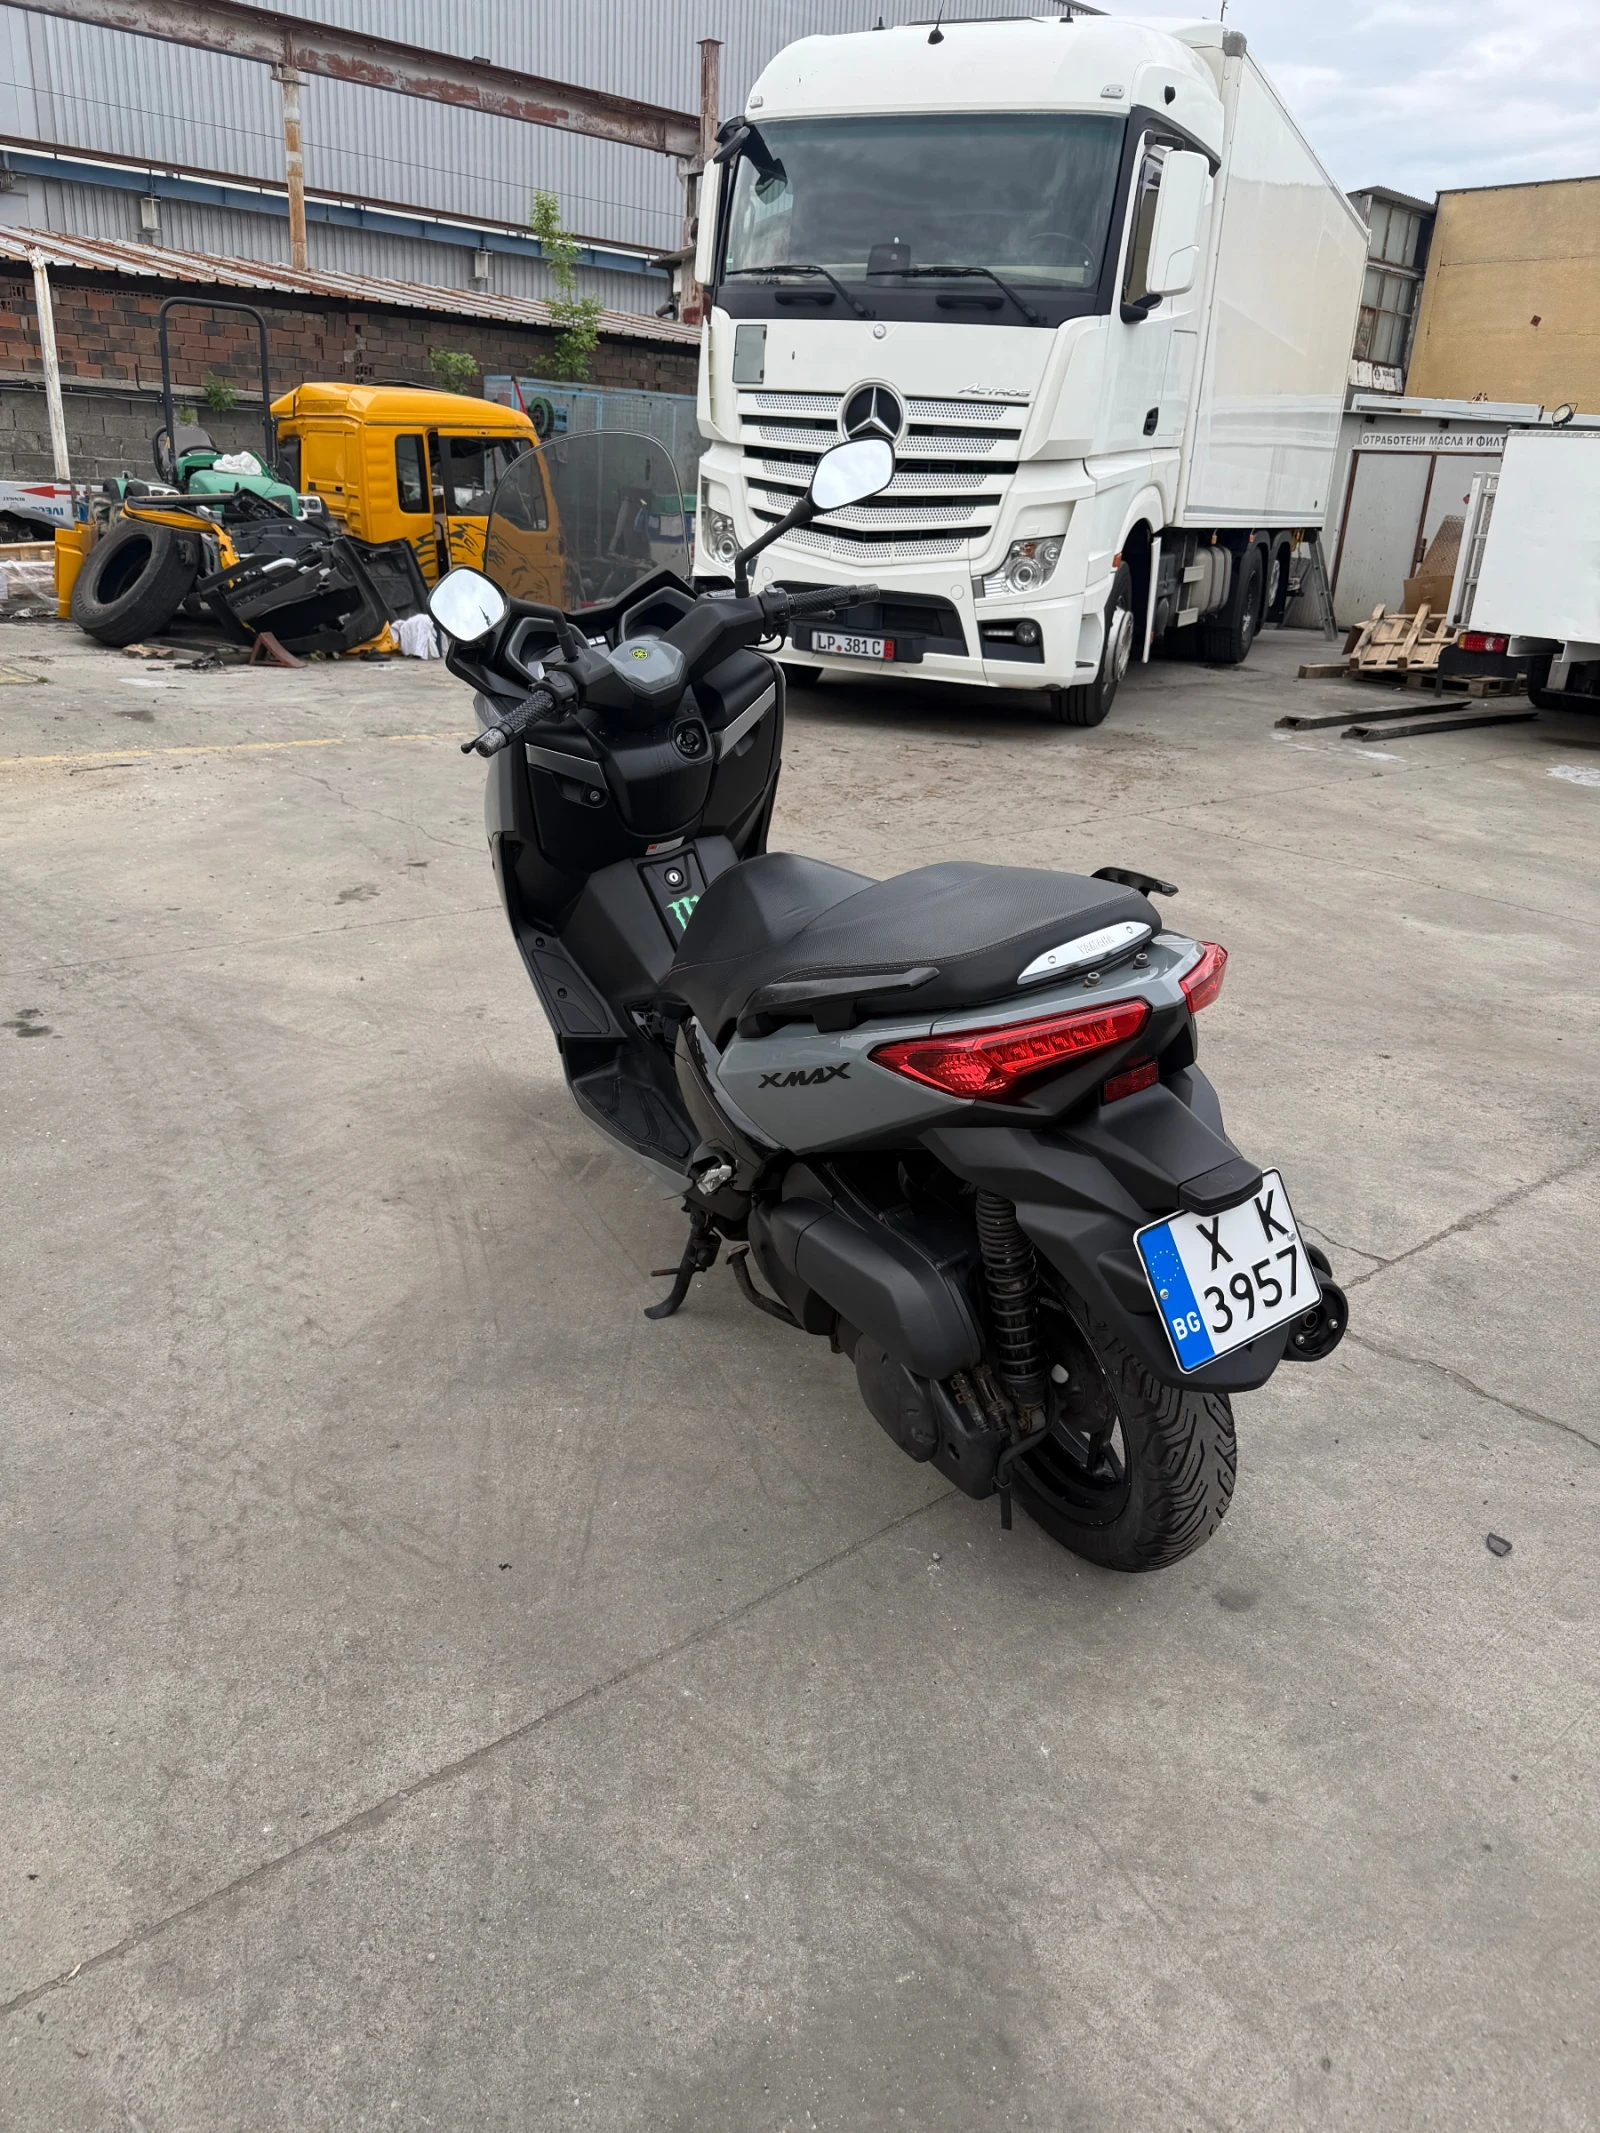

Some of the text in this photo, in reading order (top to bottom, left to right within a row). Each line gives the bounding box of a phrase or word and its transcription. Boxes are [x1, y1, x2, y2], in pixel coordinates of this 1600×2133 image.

[1362, 435, 1426, 445] ОТРАБОТЕНИ
[1429, 436, 1463, 446] МАСЛА
[1466, 436, 1473, 446] И
[818, 635, 836, 650] LP
[844, 637, 869, 654] 381
[872, 641, 881, 655] C
[1077, 934, 1115, 955] YAMAHA
[758, 1062, 852, 1088] XMAX
[1196, 1189, 1290, 1271] X K
[1203, 1244, 1298, 1334] 3957
[1171, 1311, 1201, 1341] BG
